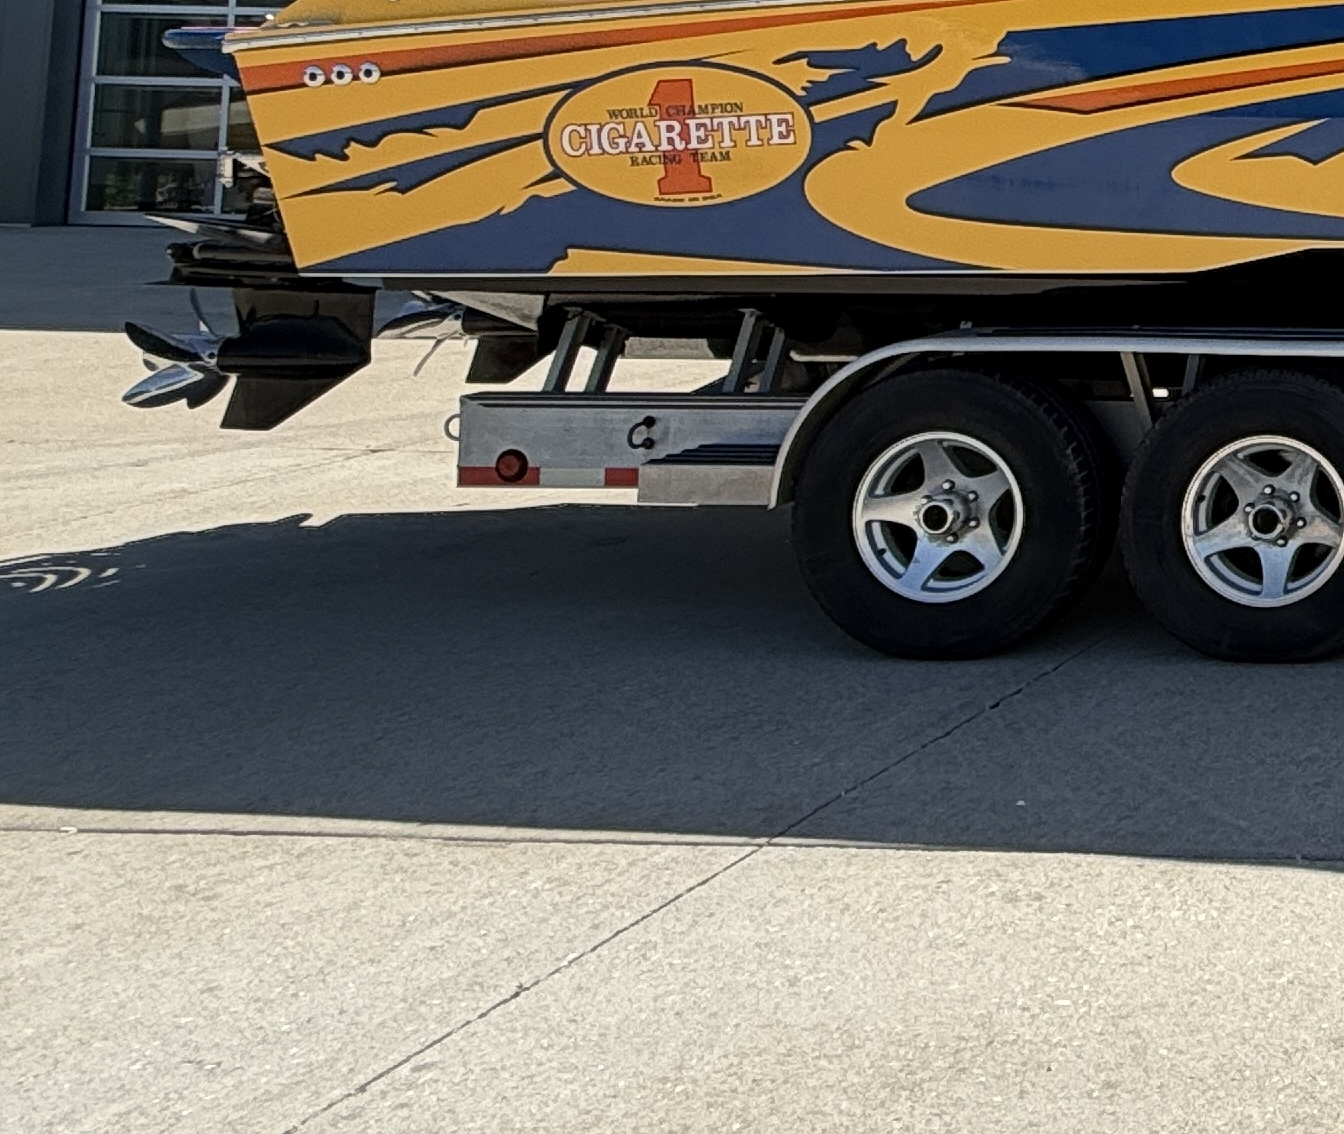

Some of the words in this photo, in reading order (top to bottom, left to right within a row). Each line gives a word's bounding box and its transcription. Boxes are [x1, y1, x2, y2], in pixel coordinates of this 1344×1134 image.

[606, 105, 659, 121] WORLD
[665, 101, 744, 117] CHAMPION
[559, 112, 797, 158] CIGARETTE
[629, 152, 682, 167] RACING
[689, 150, 732, 164] TEAM
